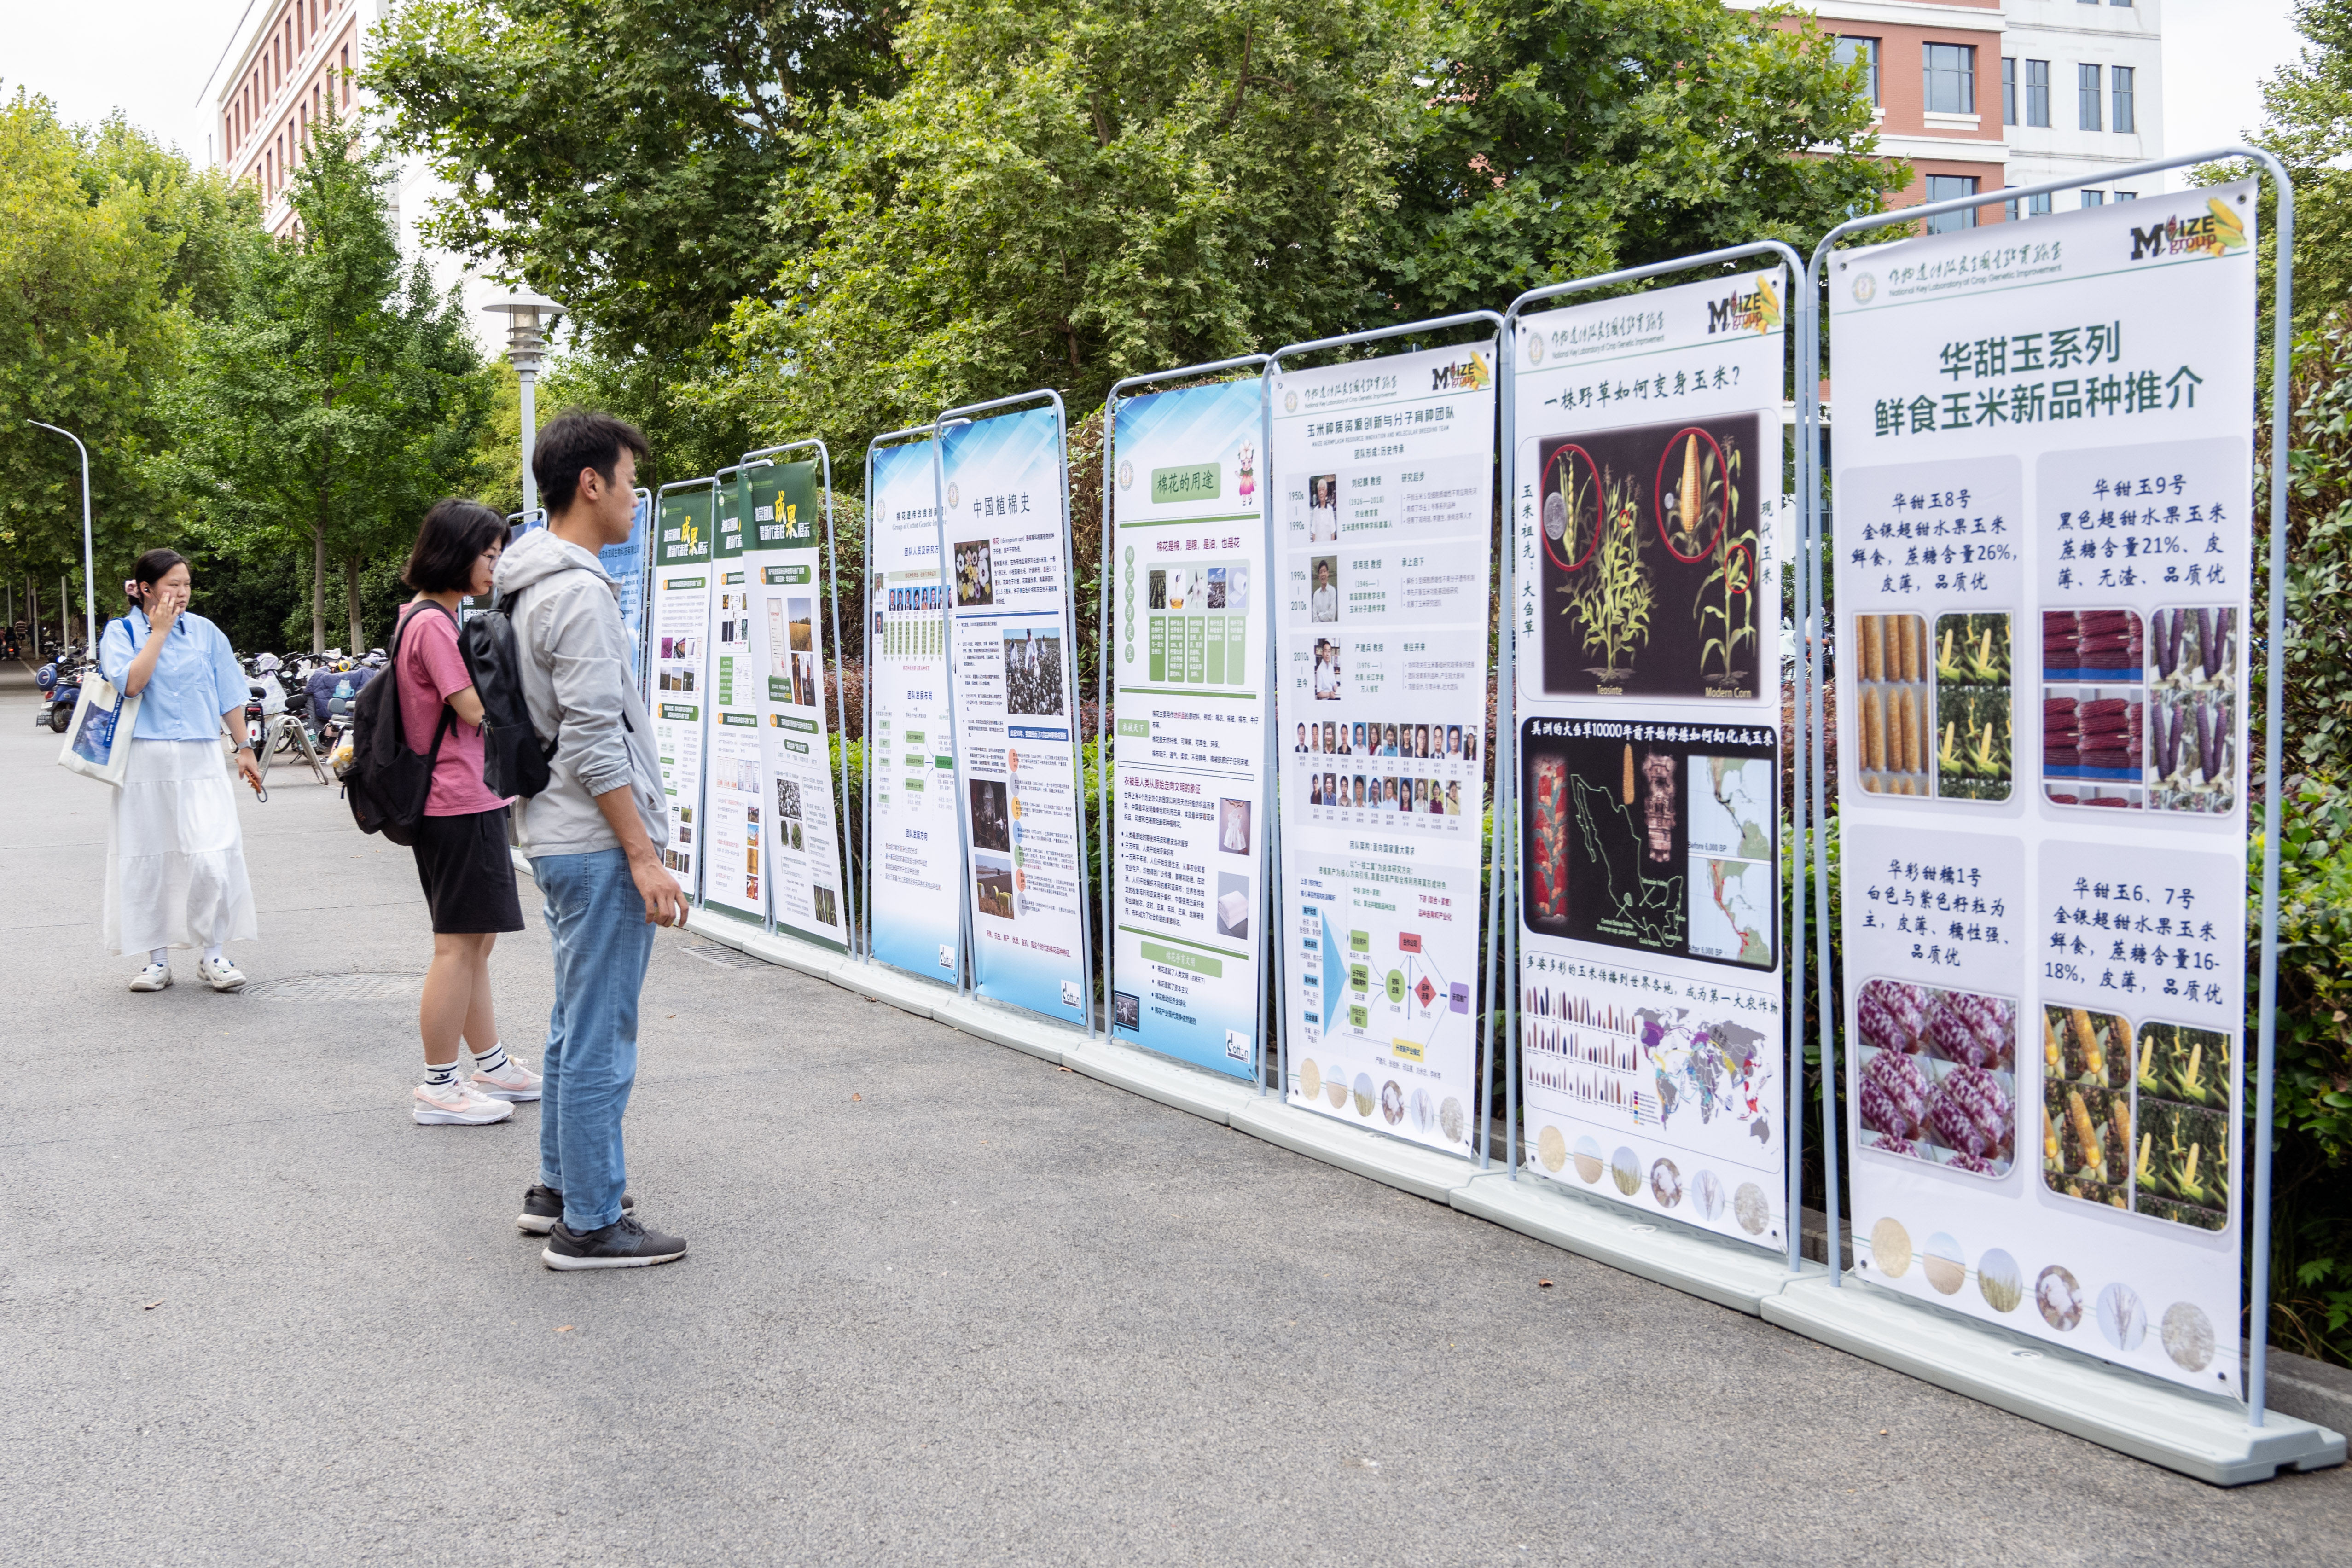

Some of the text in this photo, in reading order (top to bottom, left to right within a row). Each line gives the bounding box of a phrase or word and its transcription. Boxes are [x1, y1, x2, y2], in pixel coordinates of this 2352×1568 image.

[2169, 233, 2217, 255] group
[1889, 286, 1915, 297] National
[1916, 284, 1927, 295] Key
[1929, 279, 1962, 291] Laboratory
[1971, 276, 1987, 286] Crop
[1989, 272, 2015, 282] Genetic
[2017, 264, 2062, 278] Improvement
[1940, 320, 2120, 382] 华甜玉系列
[1874, 365, 2204, 437] 鲜食玉米新品种推介
[1307, 406, 1455, 438] 玉米种质资源创新与分子育种团队
[1157, 469, 1214, 495] 棉花的用途
[1401, 471, 1425, 483] 研究起步
[2092, 474, 2187, 501] 华甜玉9号
[973, 491, 1030, 519] 中国植棉史
[1289, 491, 1304, 501] 1950s
[1892, 489, 1971, 514] 华甜玉8号
[1289, 521, 1305, 532] 1990s
[1861, 515, 2007, 540] 金银超甜水果玉米
[2057, 502, 2227, 531] 黑色超甜水果玉米
[1760, 500, 1773, 585] 现代玉米
[1401, 556, 1425, 567] 承上启下
[1290, 571, 1306, 581] 1990s
[1291, 601, 1307, 611] 2010s
[1294, 651, 1309, 662] 2010s
[1296, 678, 1308, 688] 至今
[1705, 686, 1752, 699] Modern Corn
[1124, 776, 1201, 795] 衣被是人类从原始走向文明的象征
[2053, 905, 2217, 942] 金银超甜水果玉米
[1911, 943, 1961, 967] 品质优
